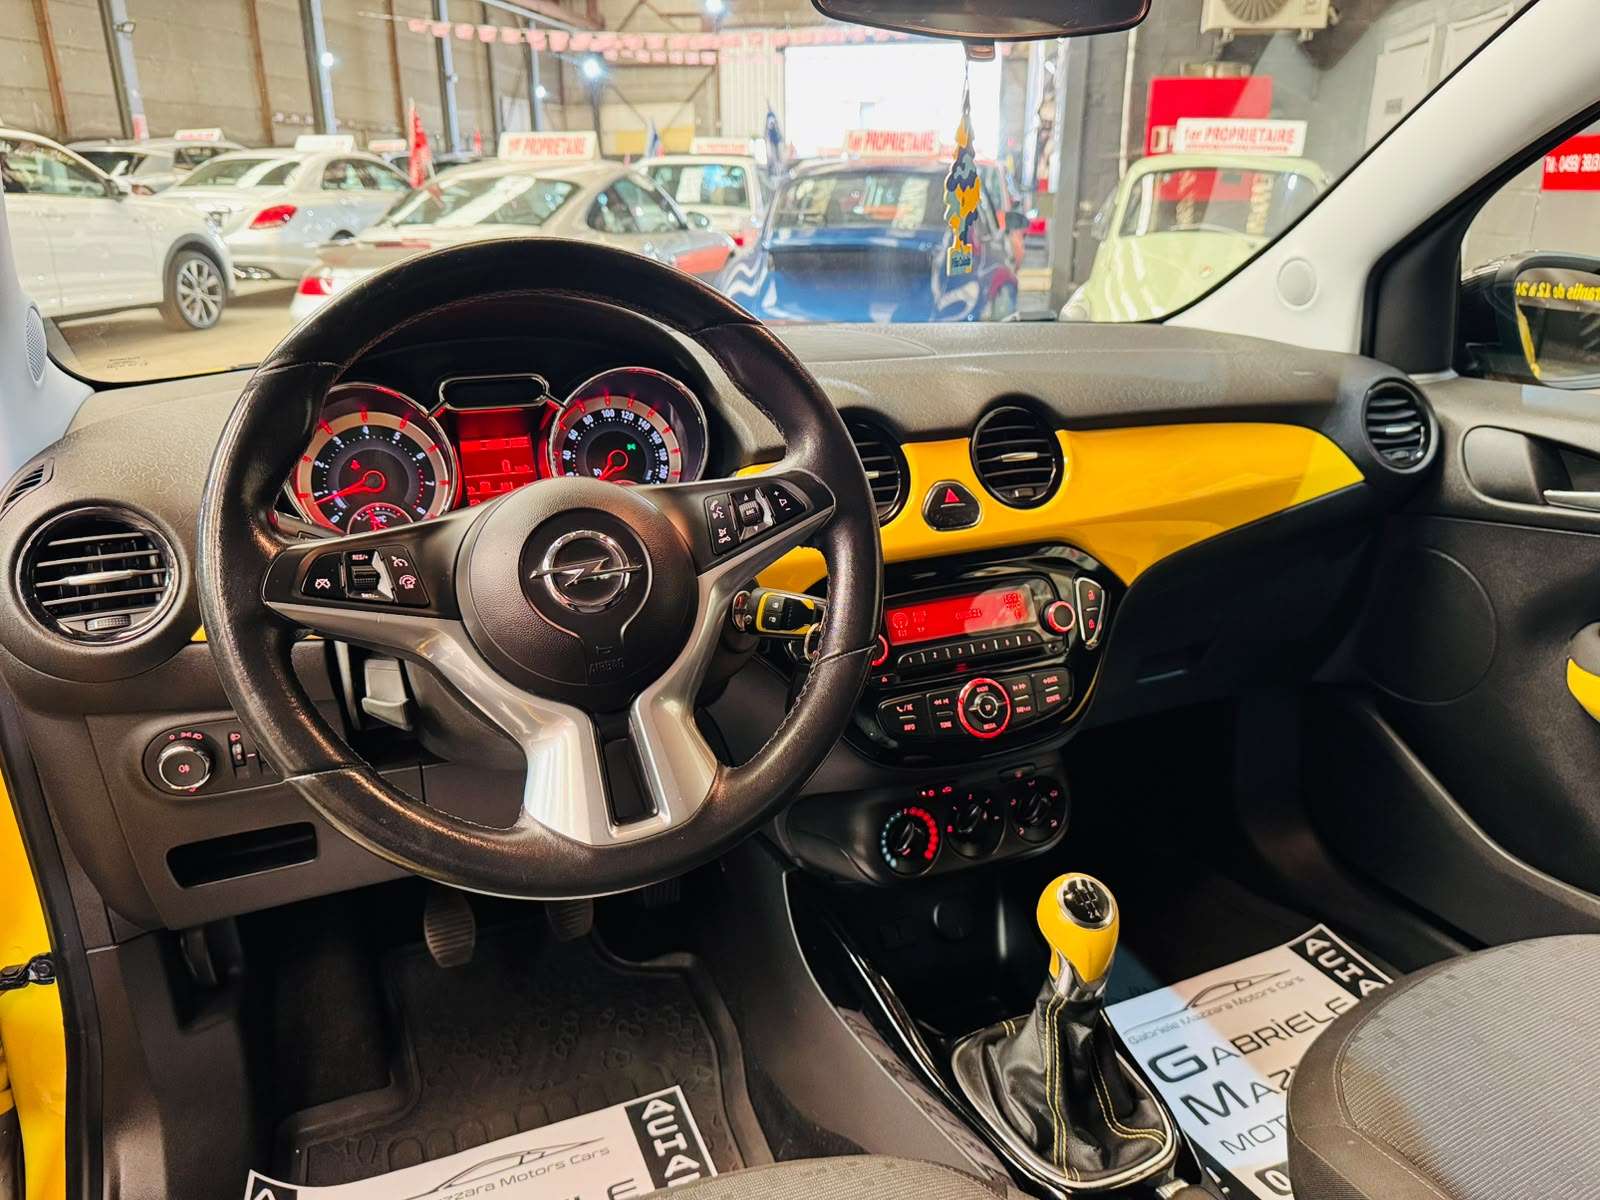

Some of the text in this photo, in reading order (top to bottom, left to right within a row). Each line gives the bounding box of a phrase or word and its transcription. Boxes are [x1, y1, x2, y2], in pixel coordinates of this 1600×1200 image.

[601, 409, 615, 418] 100
[621, 410, 635, 420] 120
[582, 414, 594, 425] 80
[638, 418, 651, 430] 140
[363, 425, 370, 434] 4
[568, 428, 579, 440] 60
[333, 436, 342, 445] 3
[393, 431, 401, 440] 5
[650, 431, 662, 444] 160
[416, 452, 426, 460] 6
[562, 449, 572, 460] 40
[659, 448, 667, 461] 180
[314, 460, 324, 468] 2
[659, 464, 668, 479] 200
[416, 506, 426, 515] 8
[331, 514, 341, 523] 0
[1128, 1020, 1180, 1045] Gabriele
[1233, 986, 1275, 1006] Motors
[1276, 975, 1306, 990] Cars
[500, 1162, 566, 1187] Motors
[569, 1147, 611, 1167] Cars
